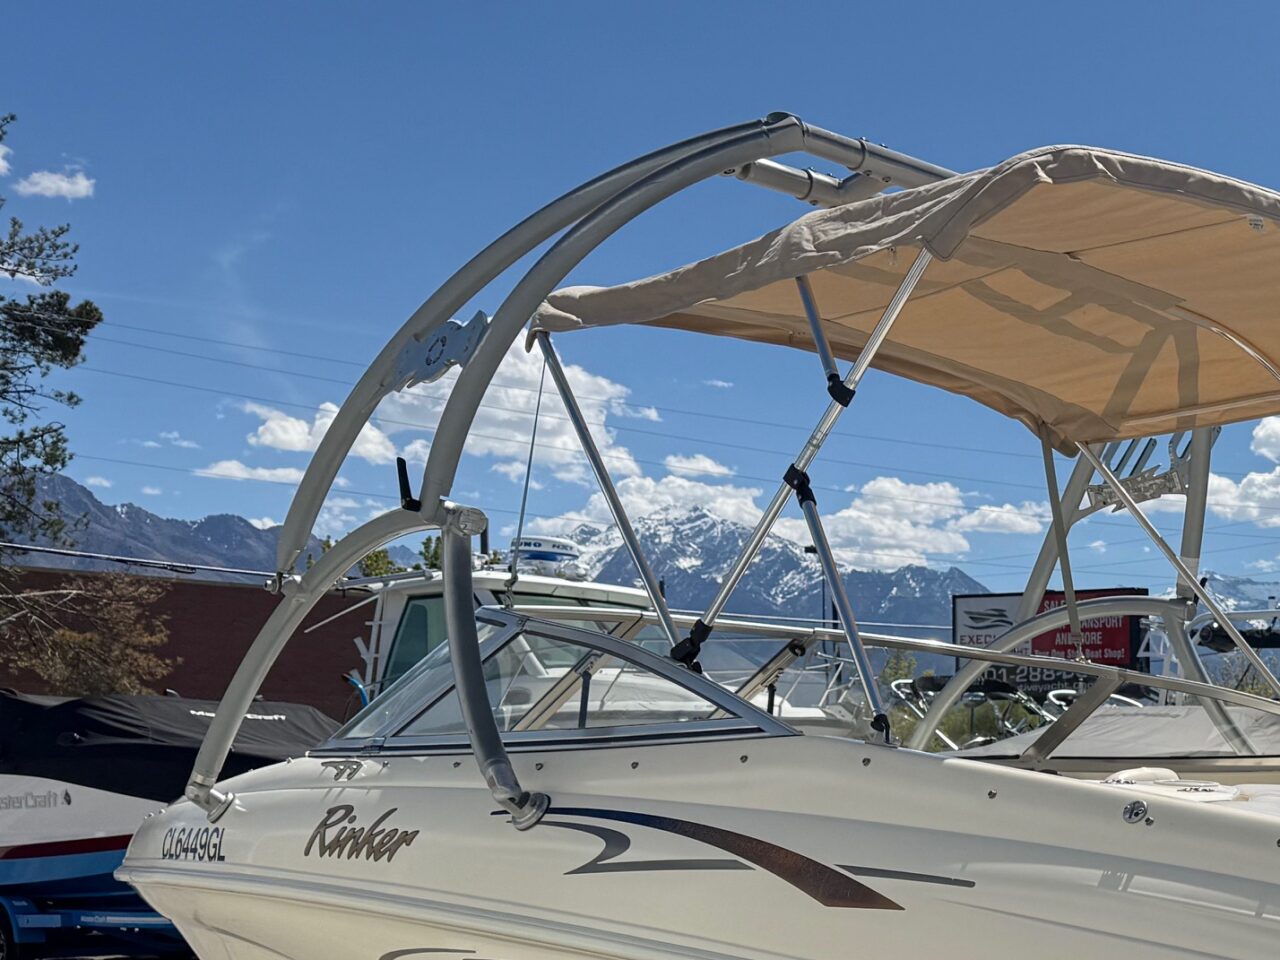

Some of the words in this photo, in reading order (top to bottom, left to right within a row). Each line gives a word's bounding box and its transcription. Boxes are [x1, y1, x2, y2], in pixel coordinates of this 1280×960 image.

[1080, 615, 1124, 629] ANSPORT
[1080, 631, 1103, 645] ORE
[161, 826, 226, 862] CL6449GL
[303, 804, 420, 863] Rinker
